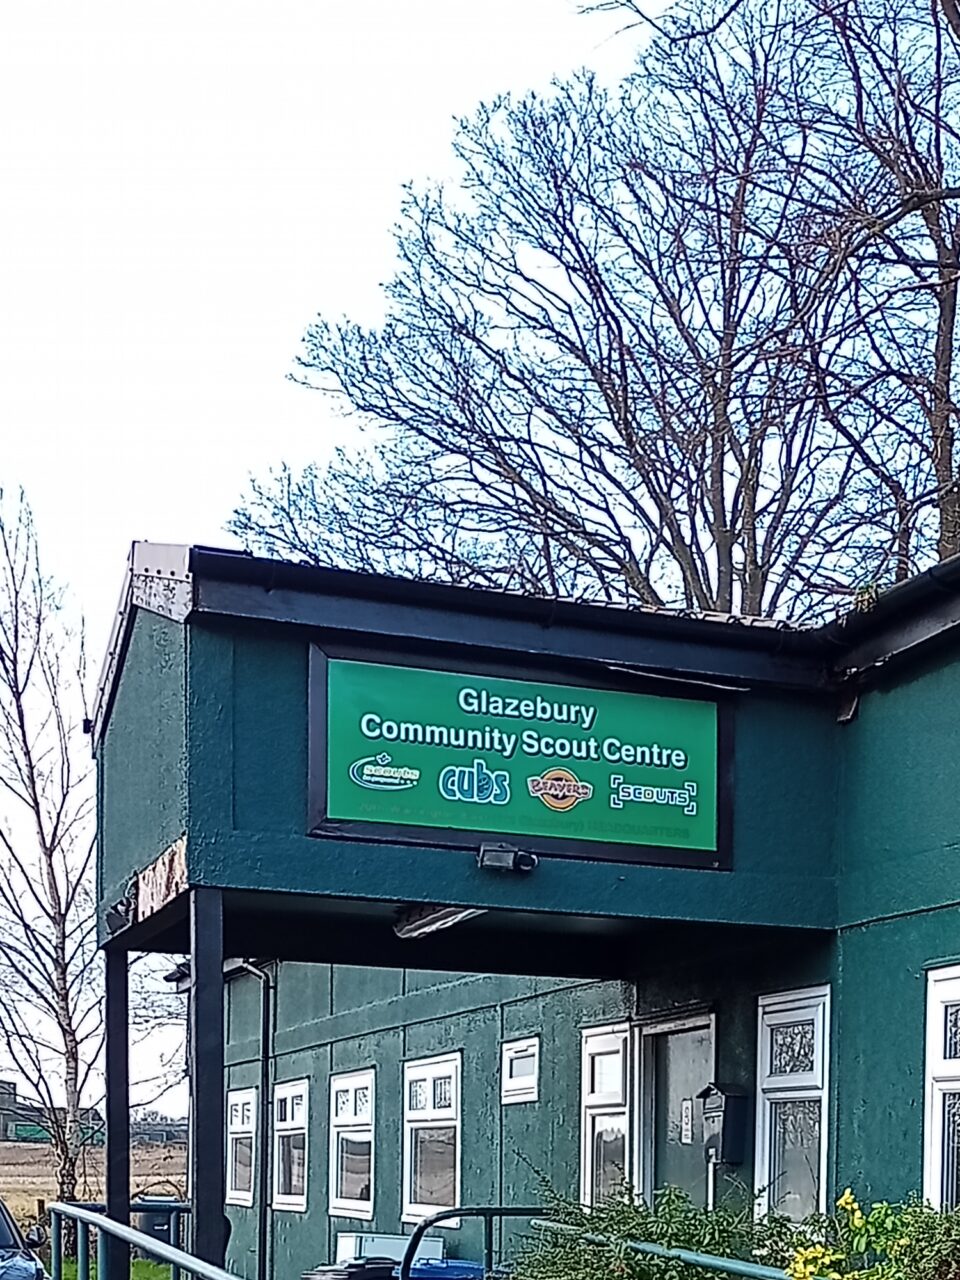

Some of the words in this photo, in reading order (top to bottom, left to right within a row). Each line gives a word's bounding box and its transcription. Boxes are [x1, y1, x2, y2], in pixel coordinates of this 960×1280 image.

[458, 687, 595, 729] Glazebury
[360, 713, 517, 757] Community
[521, 729, 599, 759] Scout
[602, 737, 686, 767] Centre
[528, 777, 593, 800] BEAVERS
[619, 784, 690, 805] SCOUTS
